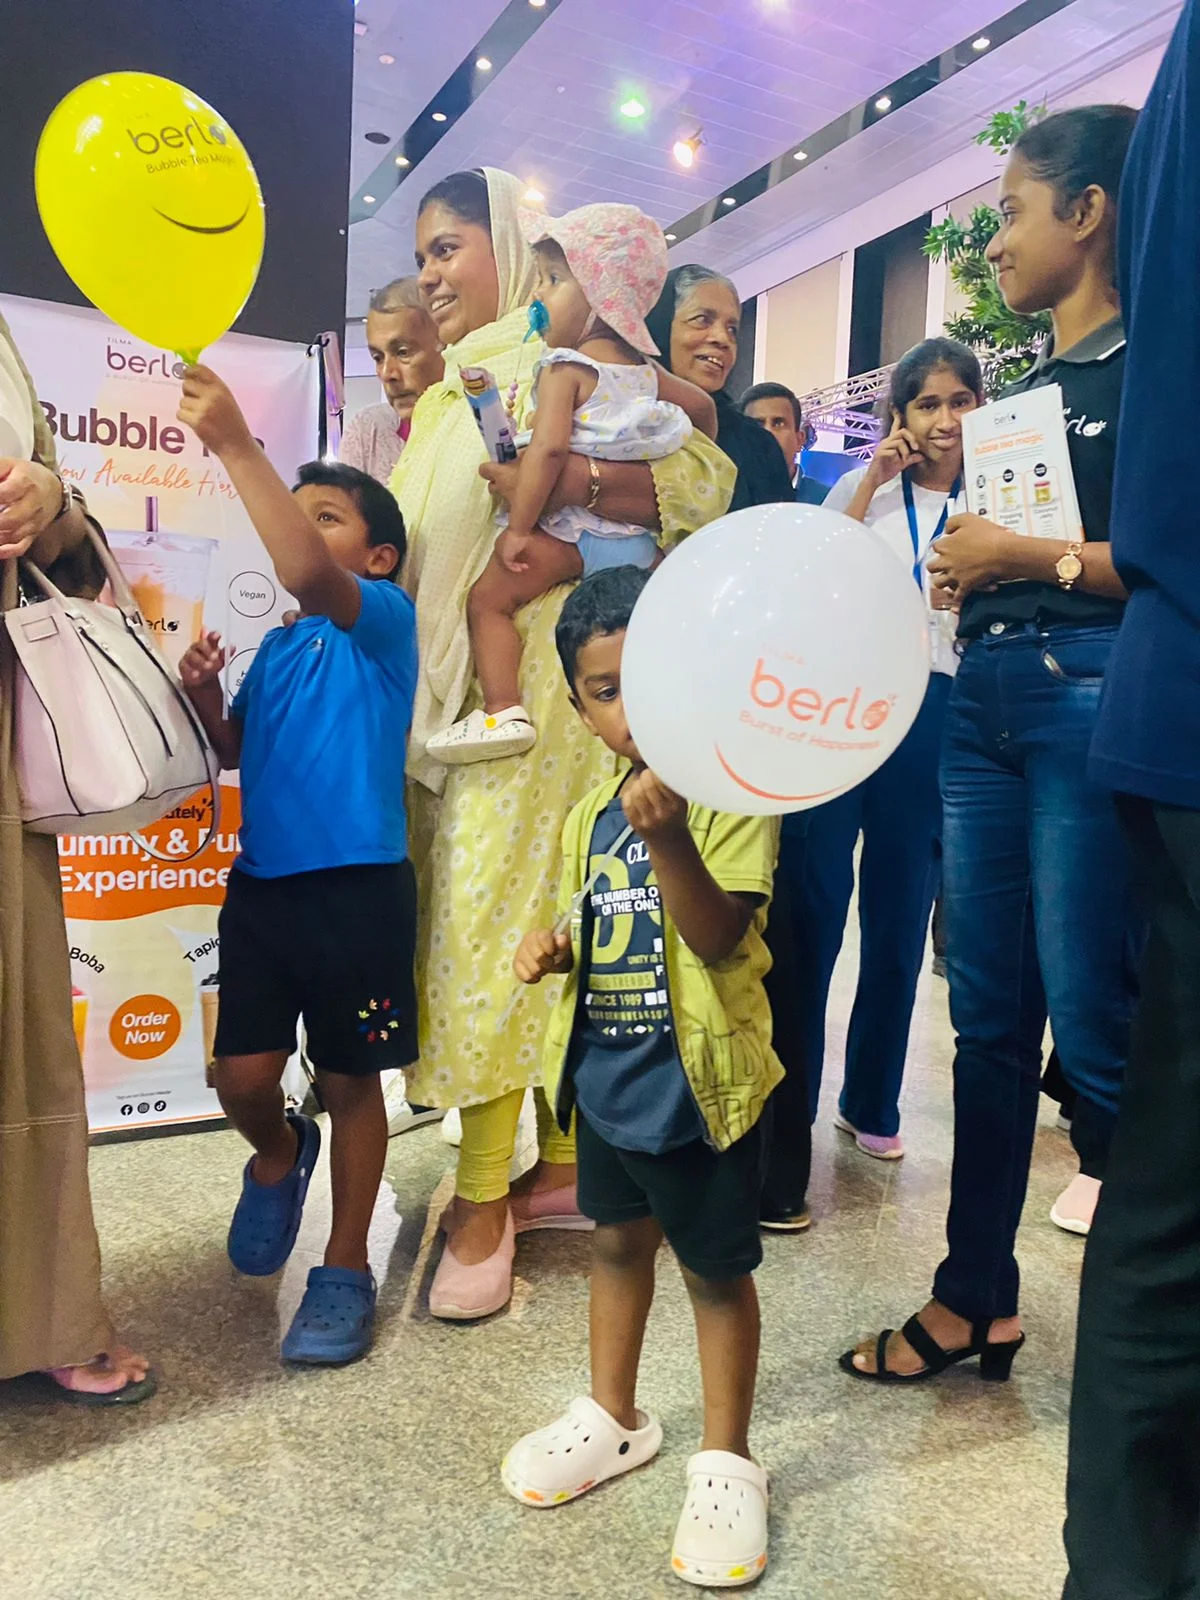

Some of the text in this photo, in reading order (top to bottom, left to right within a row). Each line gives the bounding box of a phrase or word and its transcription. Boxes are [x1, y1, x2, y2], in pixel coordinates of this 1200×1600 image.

[58, 455, 87, 482] ow
[94, 458, 193, 490] Available
[239, 589, 267, 601] Vegan
[750, 657, 890, 731] berlo
[57, 833, 160, 862] ummy
[166, 828, 190, 854] &
[627, 842, 650, 864] CL
[60, 863, 231, 898] Experience
[603, 888, 646, 903] NUMBER
[612, 901, 633, 914] THE
[69, 946, 106, 974] Boba
[121, 1010, 172, 1029] Order
[124, 1029, 166, 1046] Now
